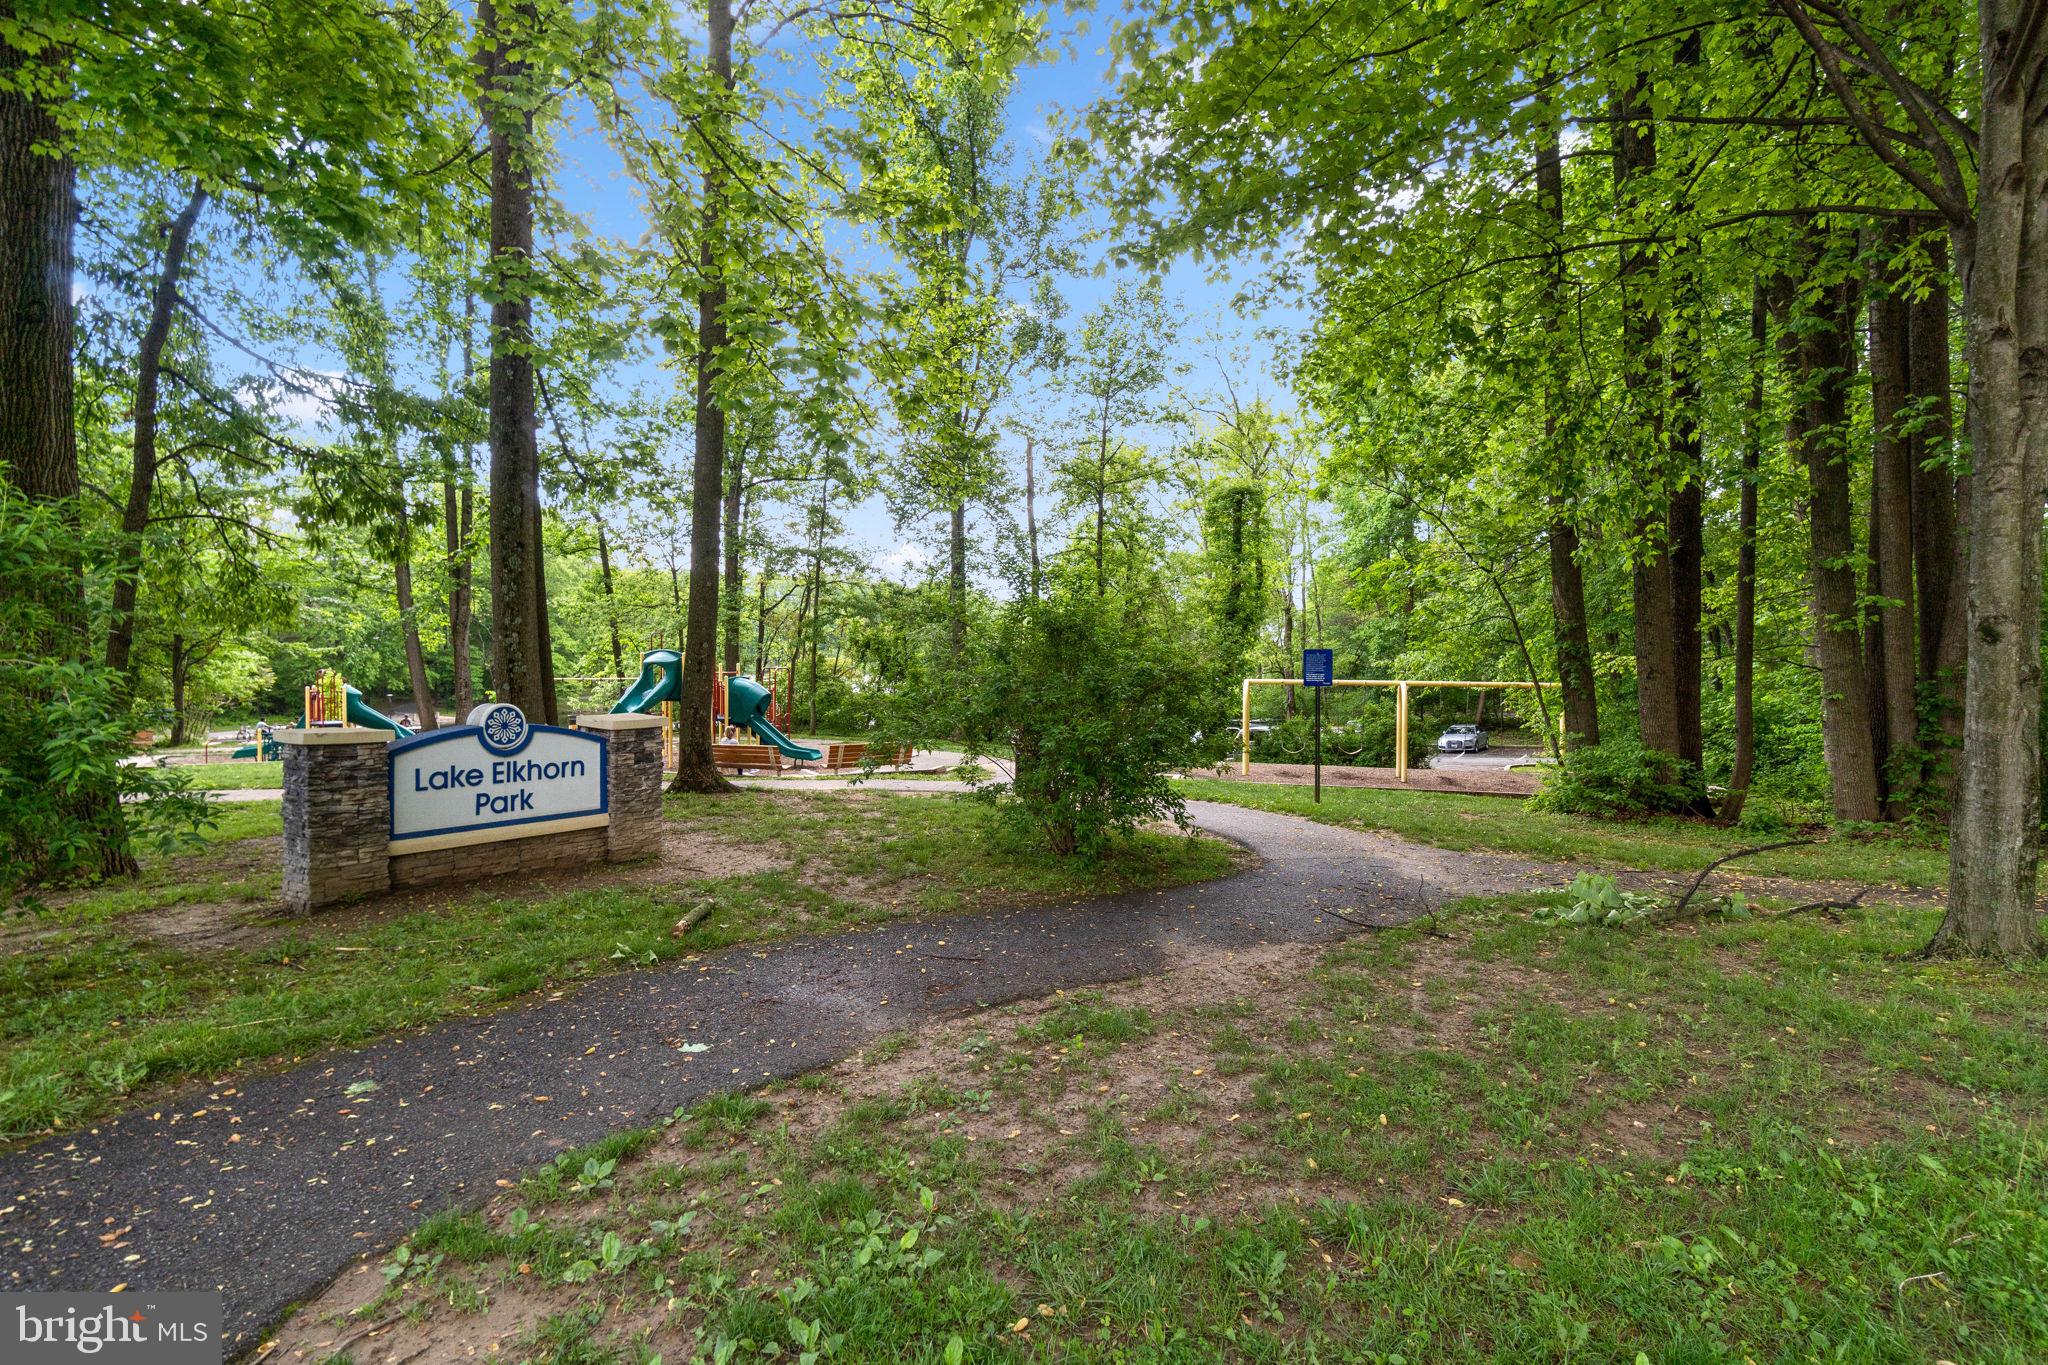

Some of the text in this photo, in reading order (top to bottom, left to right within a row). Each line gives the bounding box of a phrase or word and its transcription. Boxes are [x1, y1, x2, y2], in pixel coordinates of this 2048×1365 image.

[415, 759, 585, 791] Lake Elkhorn
[475, 788, 534, 816] Park
